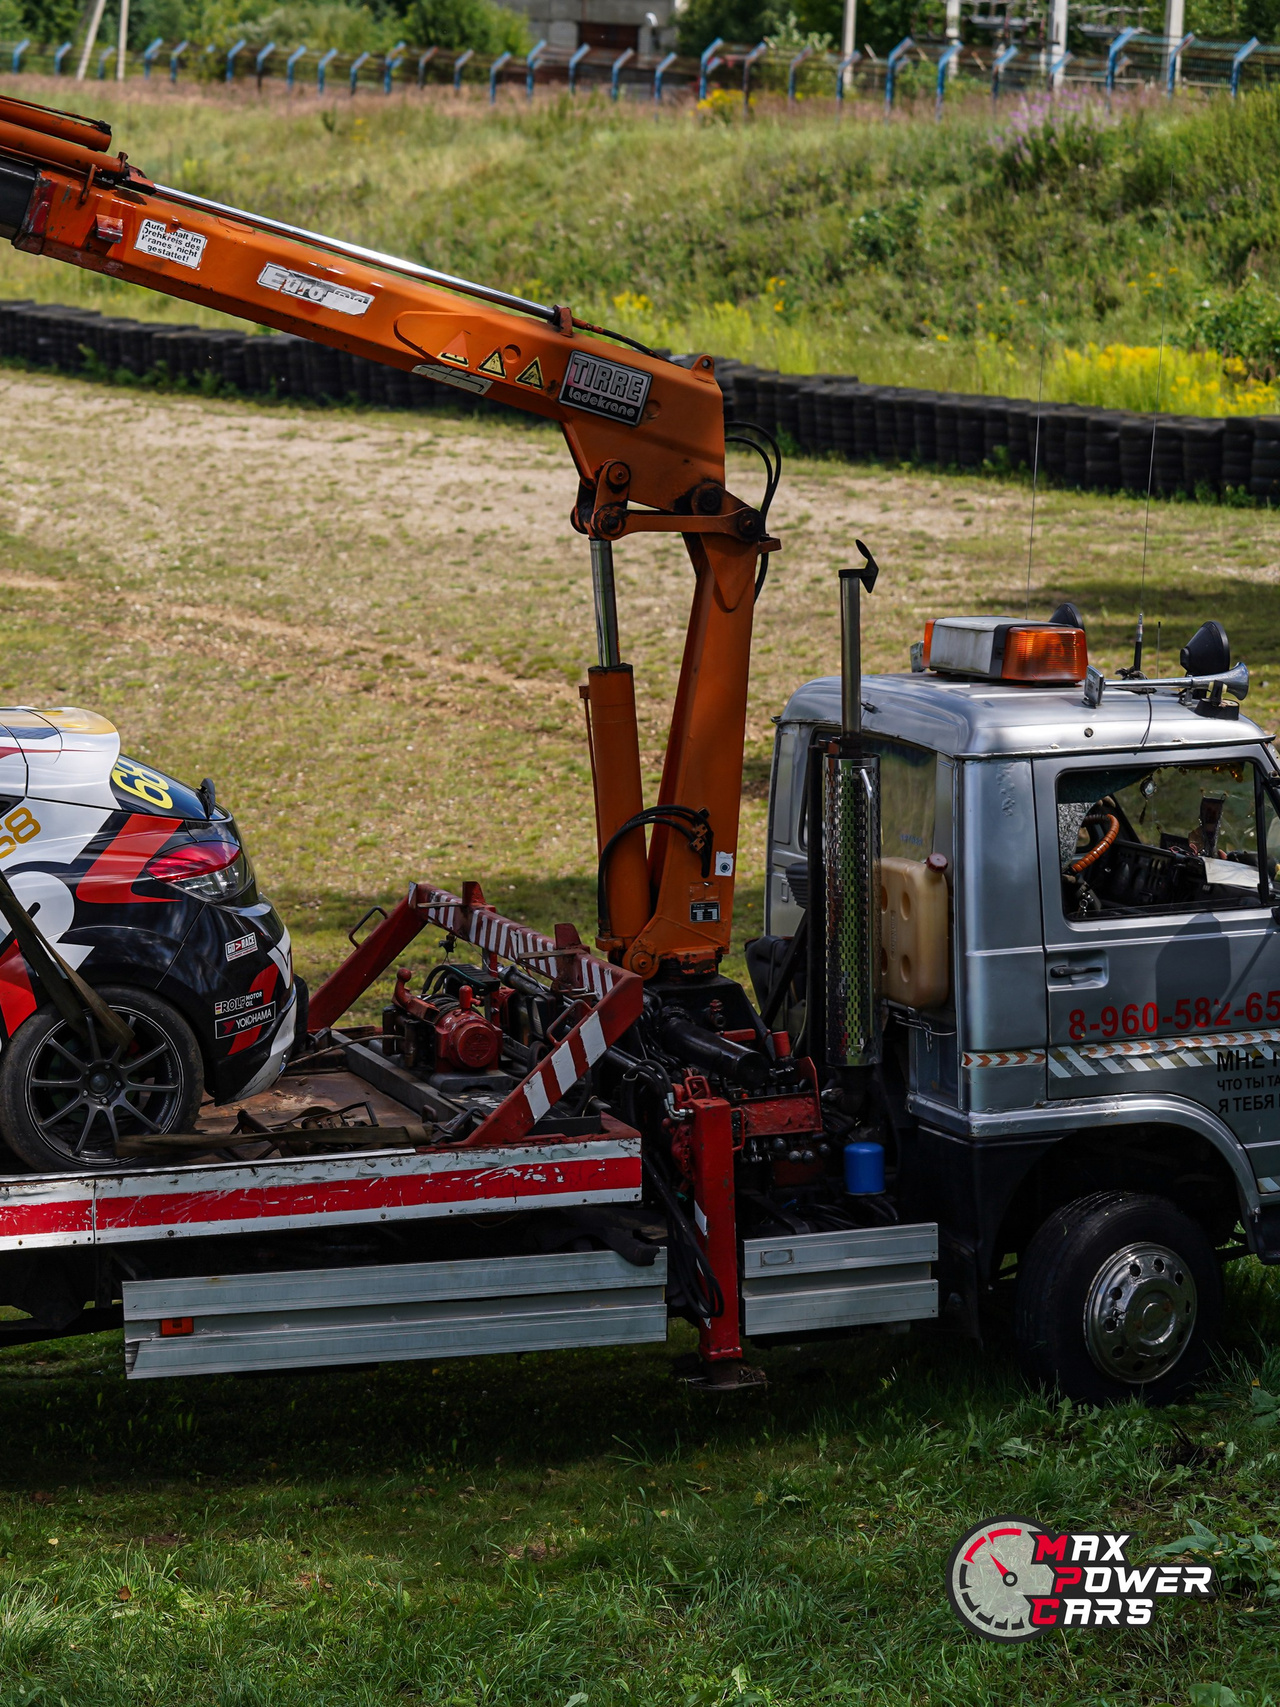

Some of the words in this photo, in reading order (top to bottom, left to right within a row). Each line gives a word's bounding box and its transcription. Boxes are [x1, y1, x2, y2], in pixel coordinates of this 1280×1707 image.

[185, 241, 200, 251] des
[191, 235, 202, 244] im
[147, 244, 190, 262] gestattet!
[176, 246, 198, 258] nicht
[573, 357, 646, 403] TIRRE
[221, 995, 246, 1014] ROLF
[245, 991, 263, 1001] MOTOR
[236, 1008, 272, 1029] YOKOHAMA
[1217, 1078, 1242, 1091] ЧТО
[1244, 1076, 1265, 1089] ТЫ
[1218, 1098, 1229, 1114] Я
[1232, 1093, 1275, 1112] ТЕБЯ
